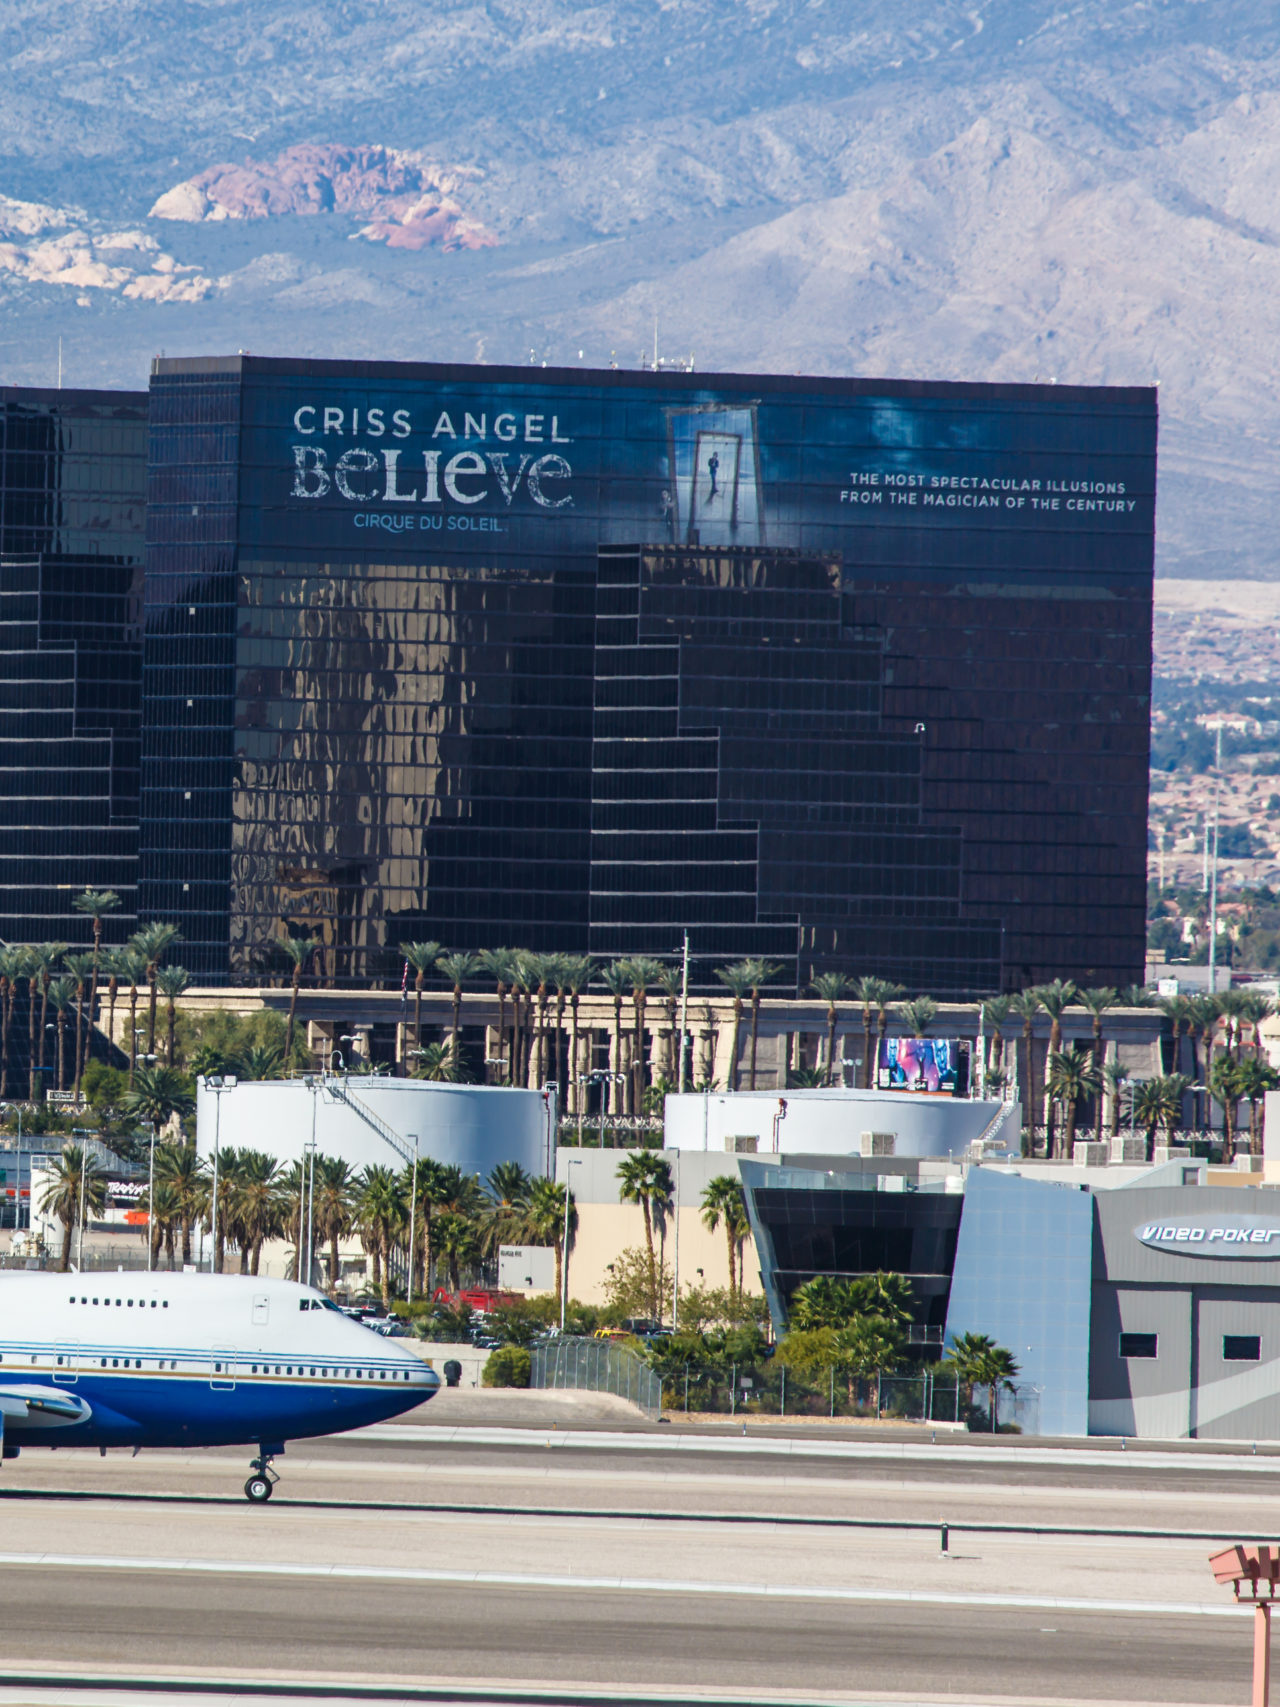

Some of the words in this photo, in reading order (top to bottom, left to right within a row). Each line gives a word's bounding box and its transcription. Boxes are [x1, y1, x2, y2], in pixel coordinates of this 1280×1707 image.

[293, 405, 412, 438] CRISS
[431, 411, 570, 443] ANGEL
[850, 472, 879, 485] THE
[885, 473, 925, 486] MOST
[931, 475, 1041, 491] SPECTACULAR
[1046, 479, 1126, 494] ILLUSIONS
[840, 490, 882, 504] FROM
[889, 492, 917, 505] THE
[923, 493, 1000, 507] MAGICIAN
[1005, 497, 1025, 508] OF
[1031, 498, 1060, 510] THE
[1066, 499, 1136, 512] CENTURY
[353, 513, 415, 534] CIRQUE
[420, 515, 443, 530] DU
[447, 515, 503, 532] SOLEIL
